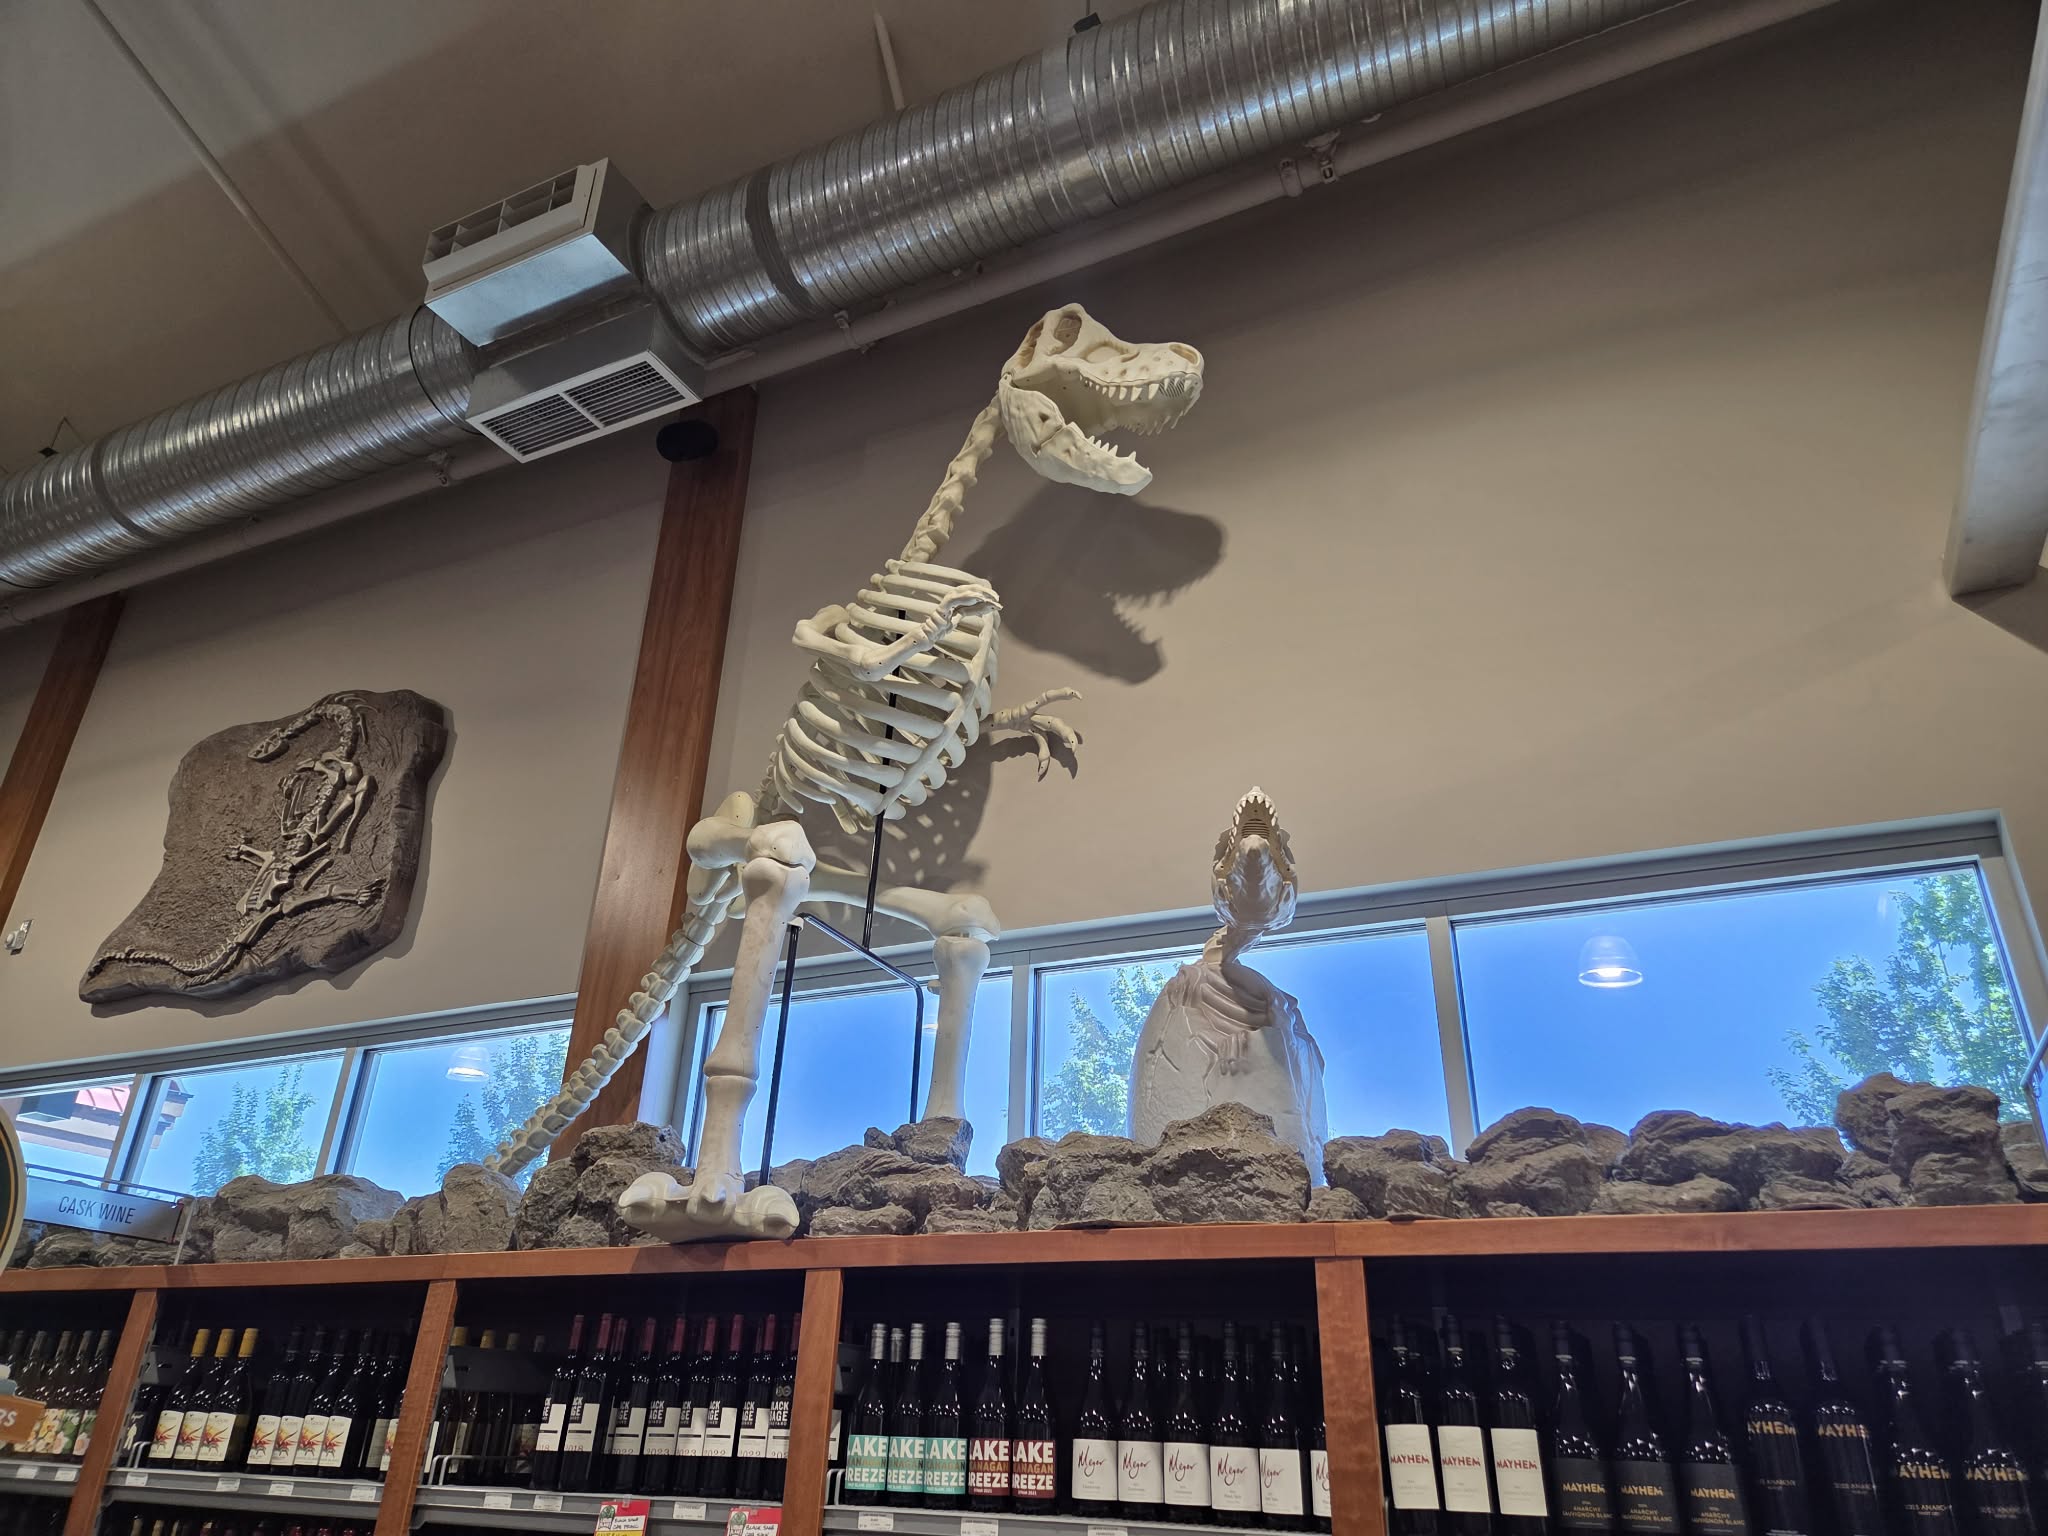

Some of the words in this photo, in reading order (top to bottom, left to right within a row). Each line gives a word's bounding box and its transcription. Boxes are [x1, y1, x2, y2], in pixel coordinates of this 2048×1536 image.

[58, 1196, 97, 1219] CASK
[99, 1203, 136, 1225] WINE
[709, 1400, 721, 1410] ACK
[743, 1401, 755, 1411] ACK
[648, 1409, 664, 1420] AGE
[1747, 1421, 1797, 1437] AYHEM
[889, 1438, 924, 1458] AKE
[1391, 1454, 1430, 1464] MAYHEM
[1441, 1456, 1481, 1467] MAYHEM
[1496, 1459, 1538, 1470] MAYHEM
[887, 1470, 923, 1485] REEZE
[1898, 1464, 1952, 1479] AYHEM
[1562, 1482, 1606, 1494] MAYHEM
[1620, 1484, 1664, 1496] MAYHEM
[1690, 1487, 1736, 1499] MAYHEM
